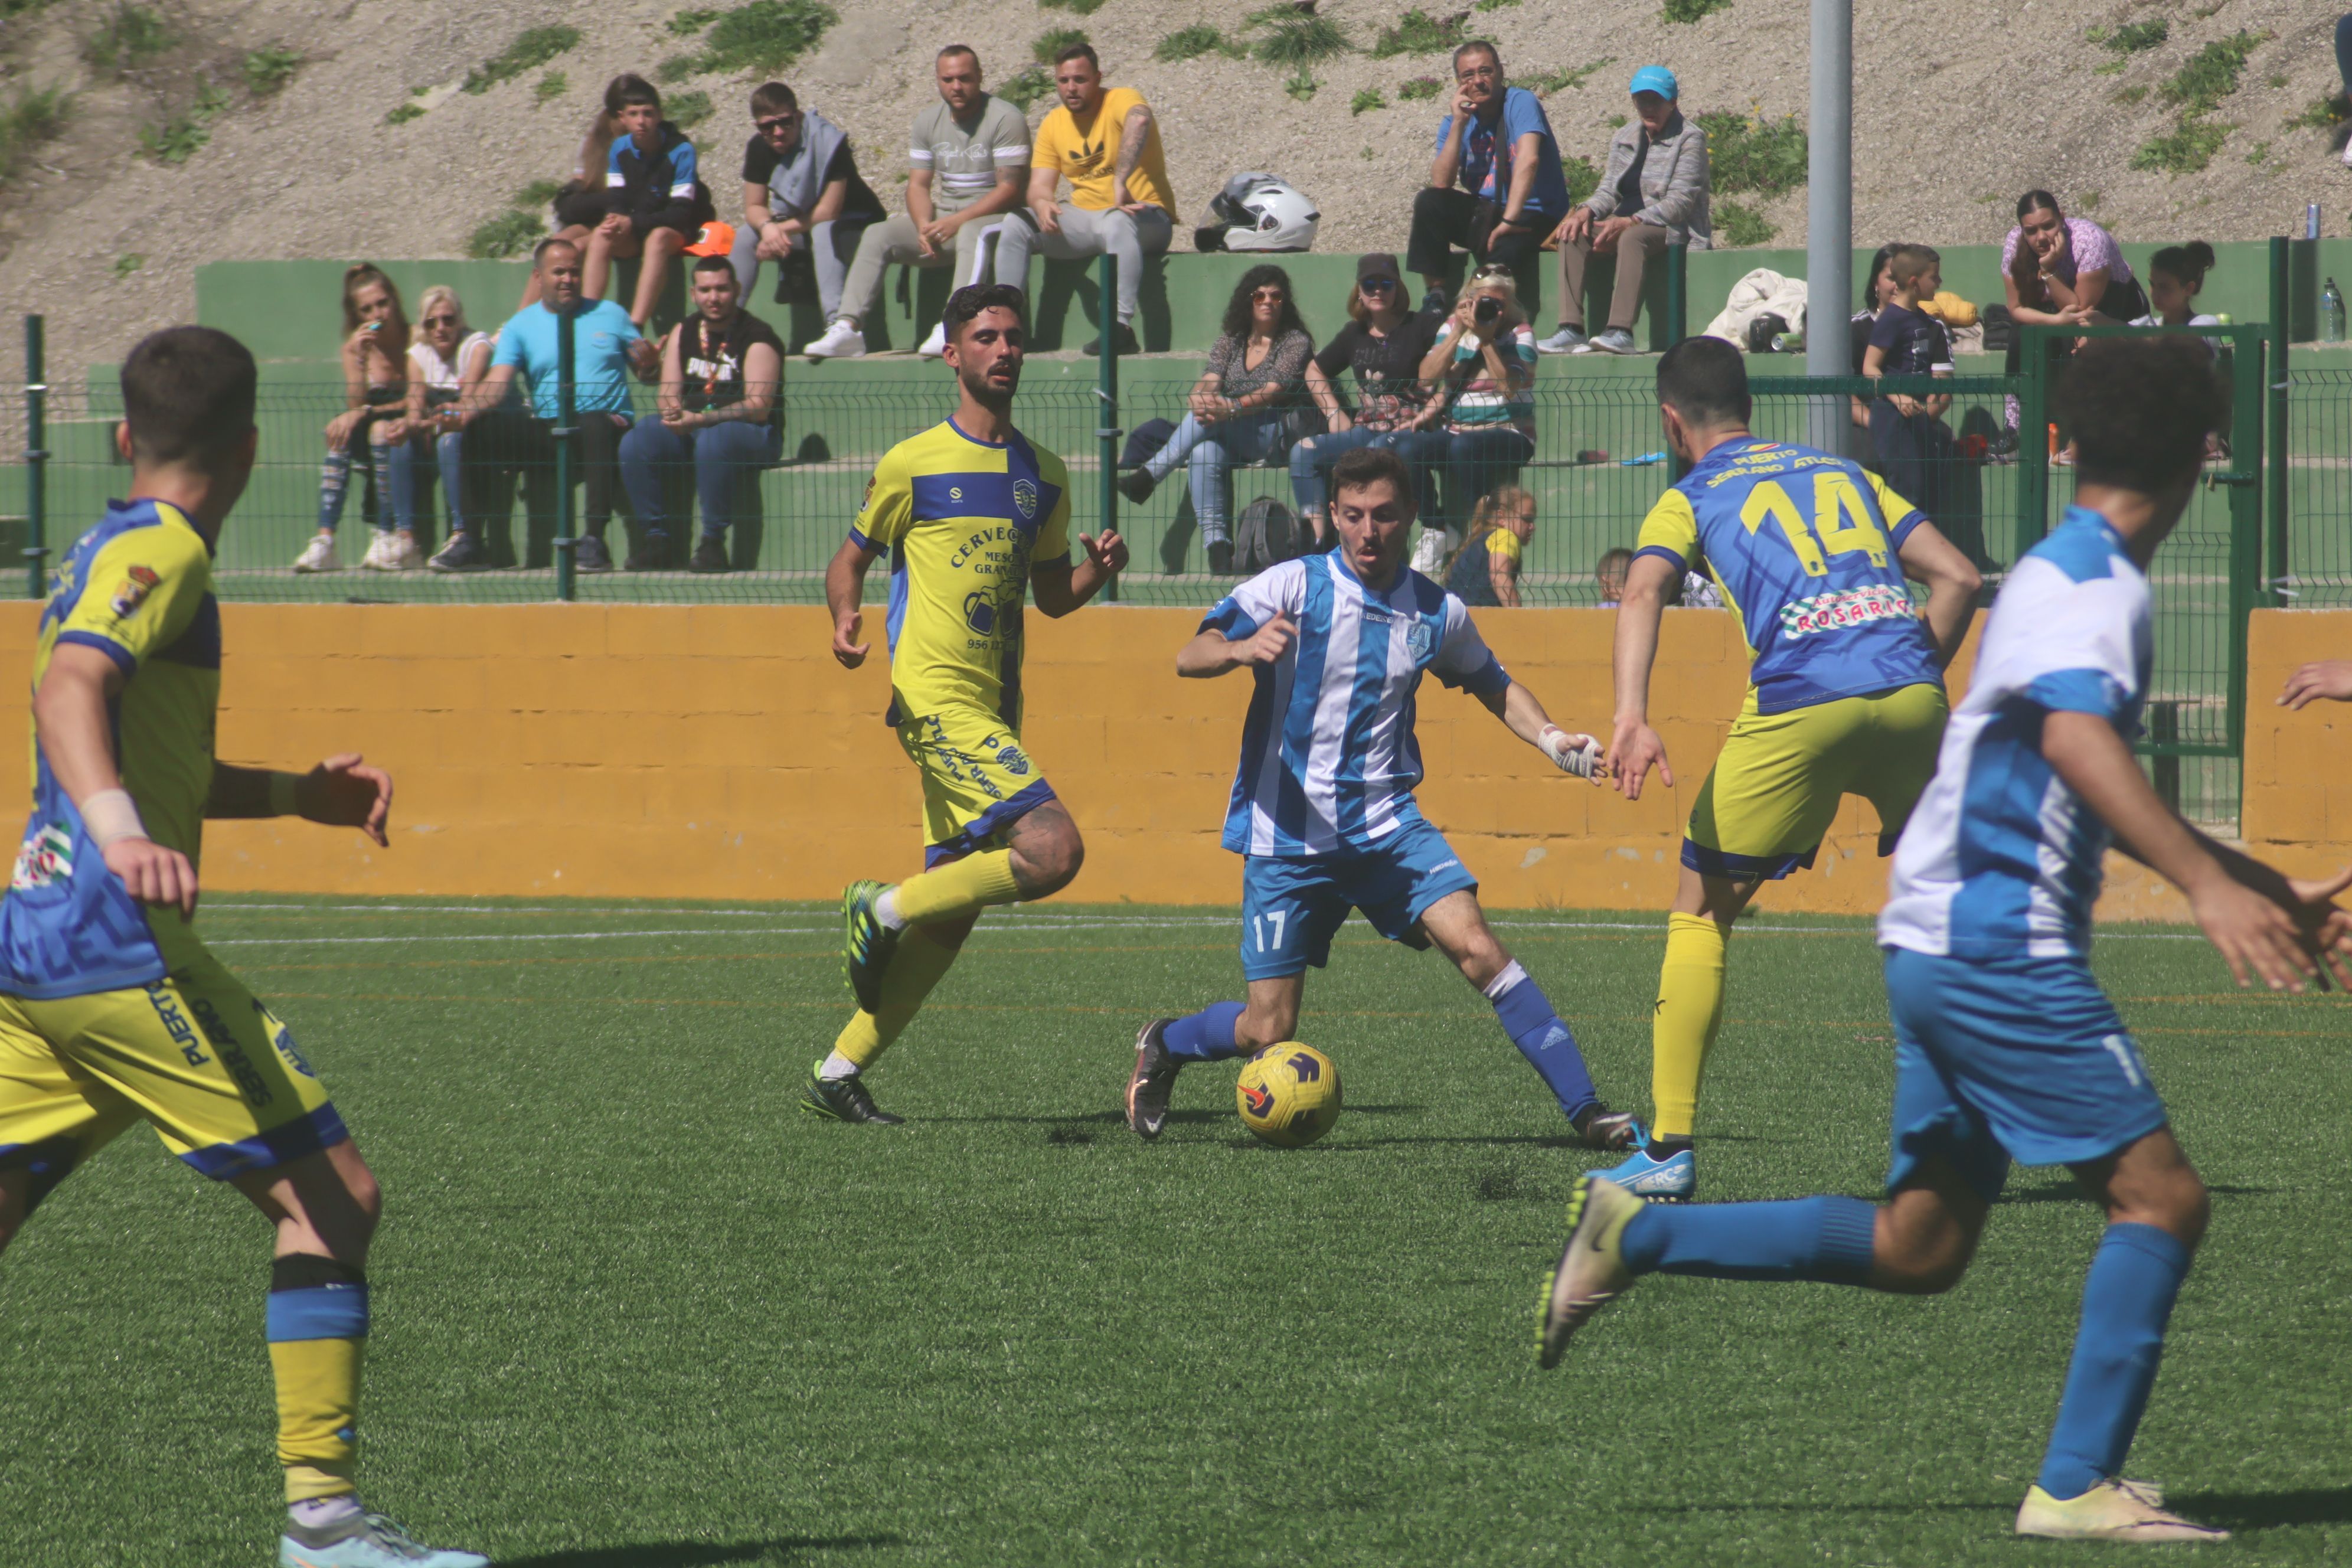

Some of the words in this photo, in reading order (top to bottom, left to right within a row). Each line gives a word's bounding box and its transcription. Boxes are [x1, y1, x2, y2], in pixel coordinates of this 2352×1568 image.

[1733, 449, 1798, 465] PUERTO
[1706, 464, 1785, 488] SERRANO
[1739, 472, 1889, 577] 14
[1812, 587, 1889, 607] Autoservicio
[968, 639, 988, 649] 956
[1253, 910, 1286, 952] 17
[1540, 1033, 1569, 1050] adidas
